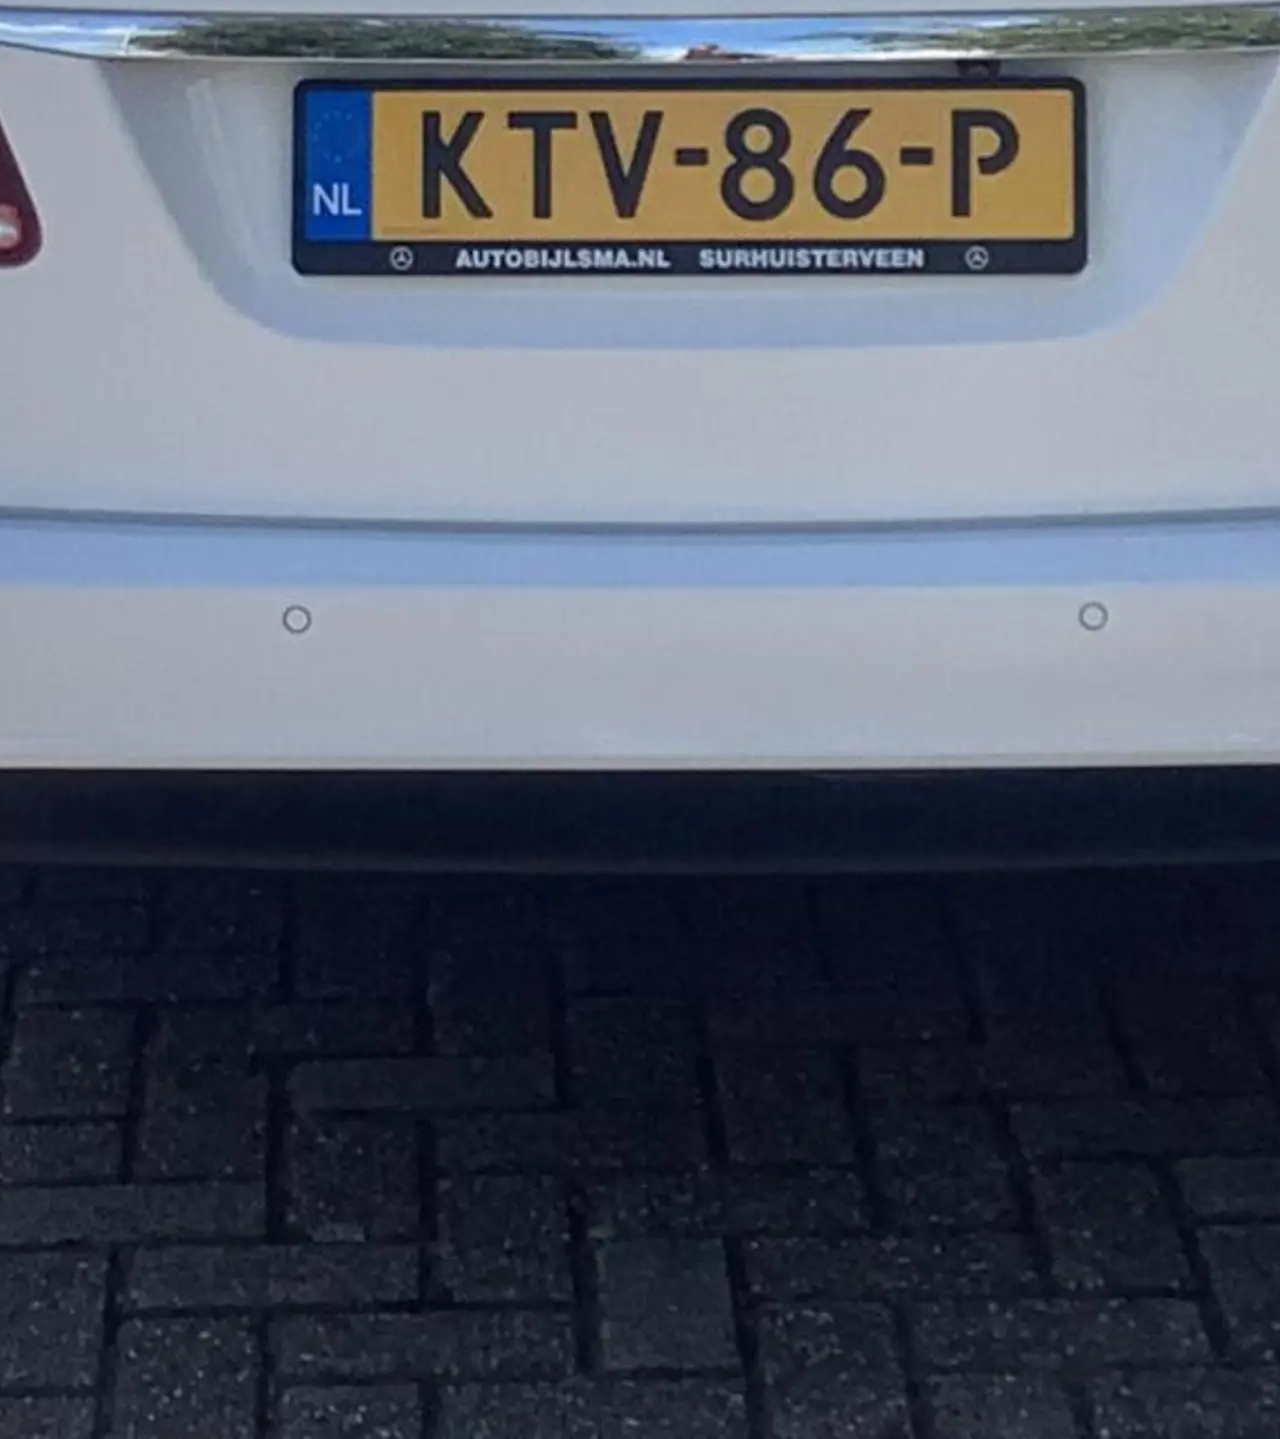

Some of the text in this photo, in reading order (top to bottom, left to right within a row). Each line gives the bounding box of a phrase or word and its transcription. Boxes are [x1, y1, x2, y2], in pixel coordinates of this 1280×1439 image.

[421, 107, 1021, 222] KTV-86-P
[312, 182, 362, 217] NL
[455, 248, 925, 269] AUTOBIJLSMA.NL SURHUISTERVEEN
